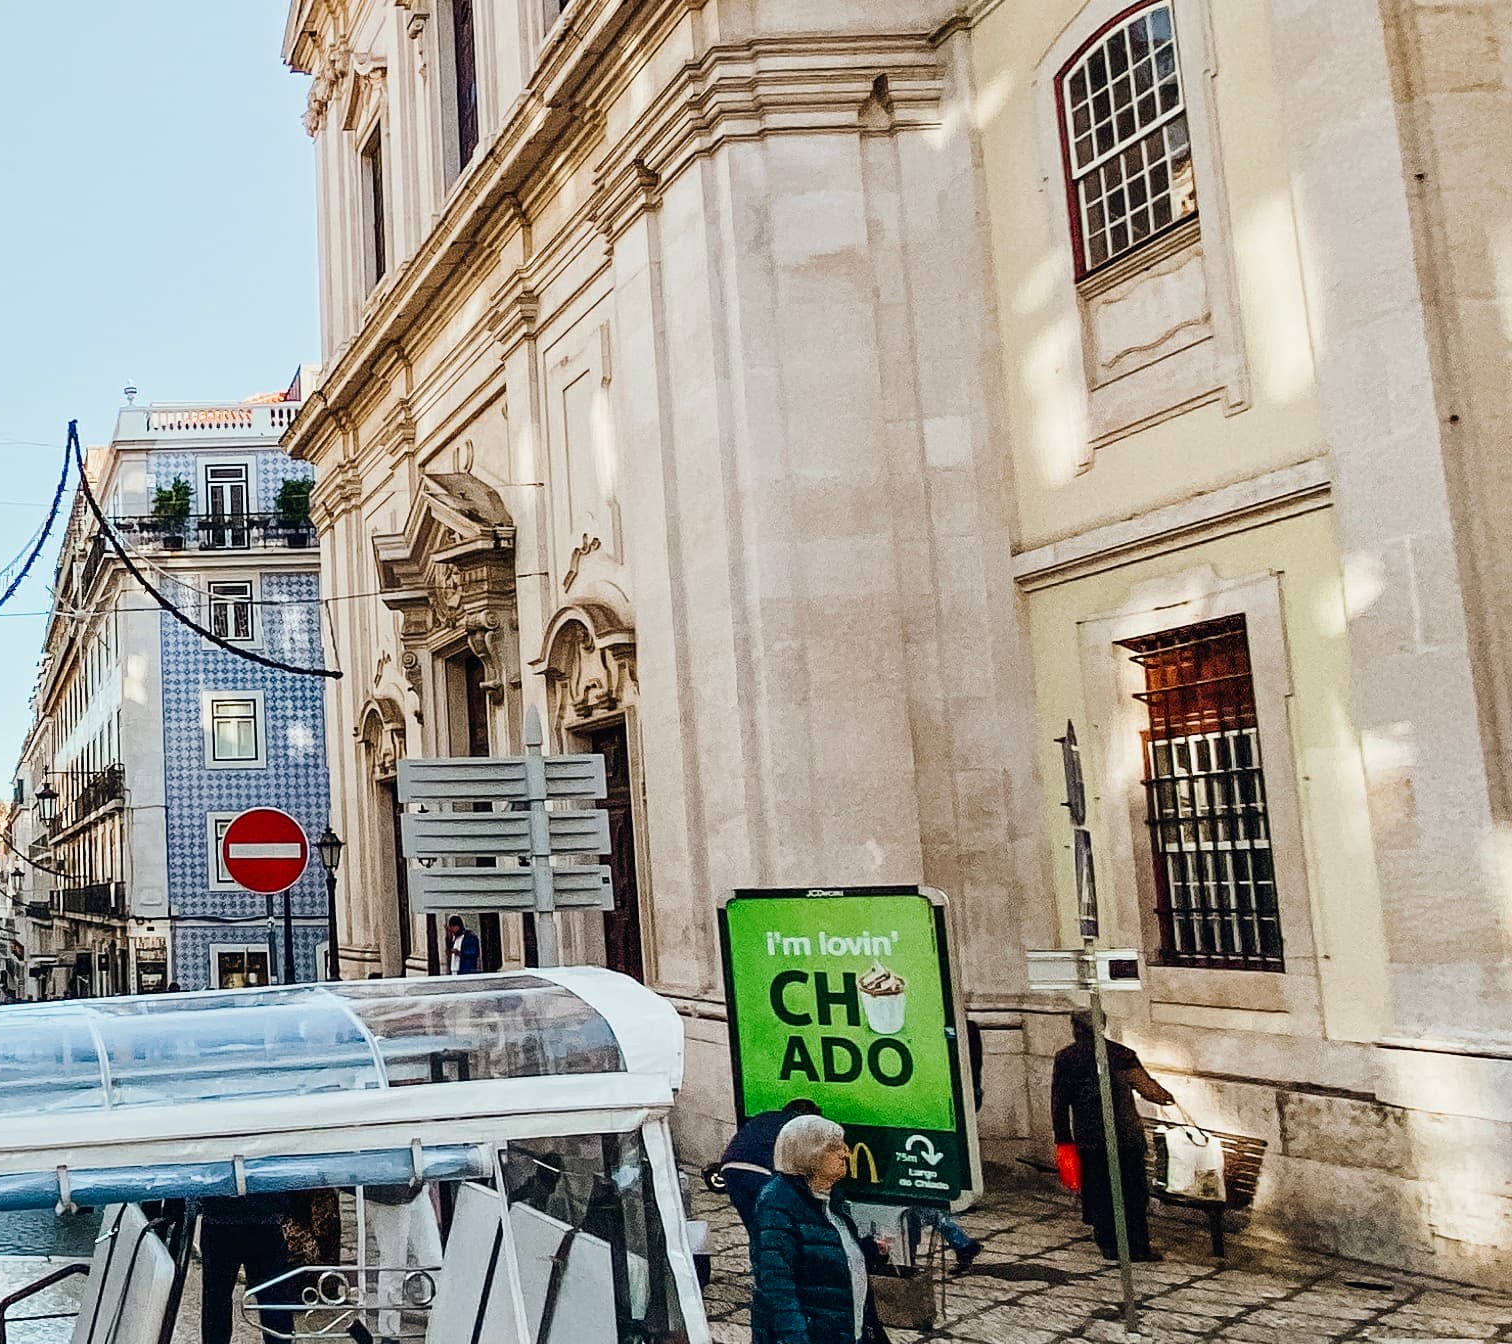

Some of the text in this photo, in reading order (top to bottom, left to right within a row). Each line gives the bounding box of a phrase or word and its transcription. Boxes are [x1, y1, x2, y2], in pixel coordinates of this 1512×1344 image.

[766, 930, 899, 956] i'm lovin'
[779, 1035, 914, 1087] ADO
